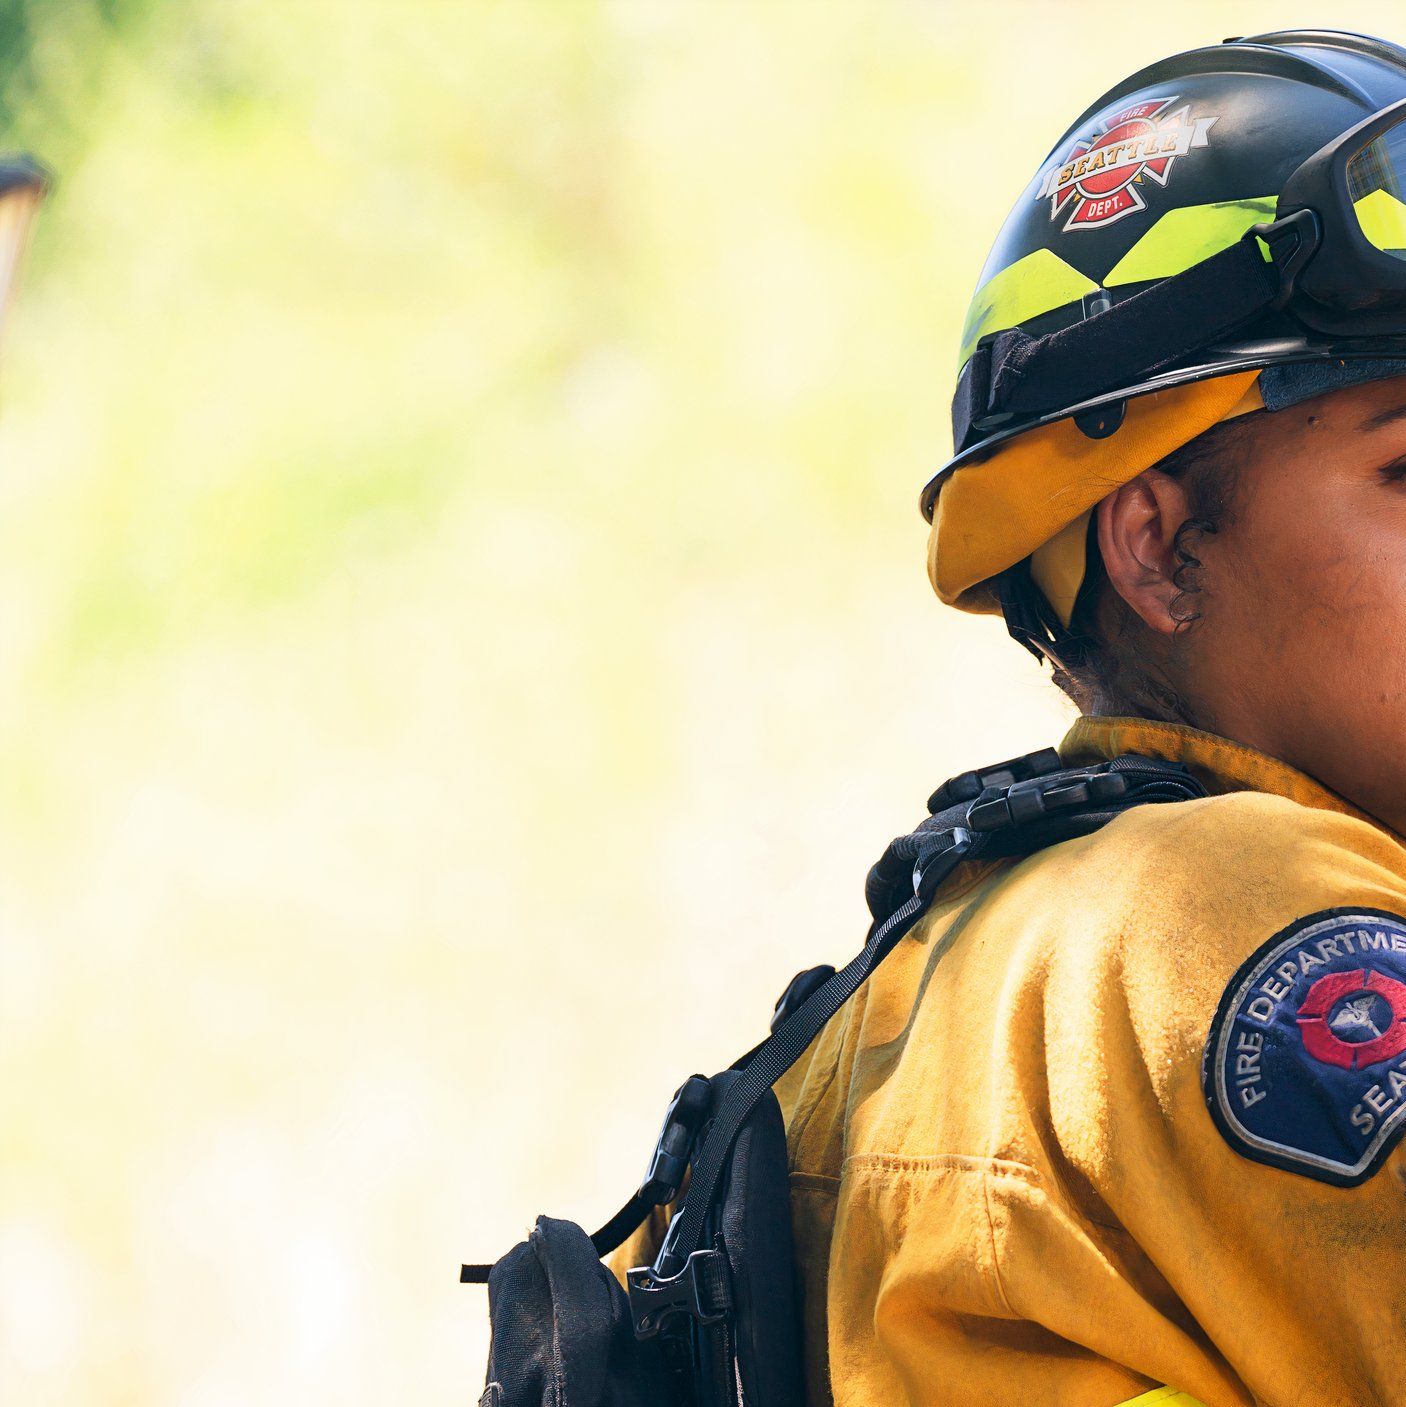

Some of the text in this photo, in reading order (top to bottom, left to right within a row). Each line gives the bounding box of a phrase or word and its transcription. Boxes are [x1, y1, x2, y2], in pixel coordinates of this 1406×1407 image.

[1119, 105, 1149, 122] FIRE
[1057, 132, 1179, 187] SEATTLE
[1087, 195, 1123, 218] DEPT.
[1235, 1031, 1267, 1109] FIRE
